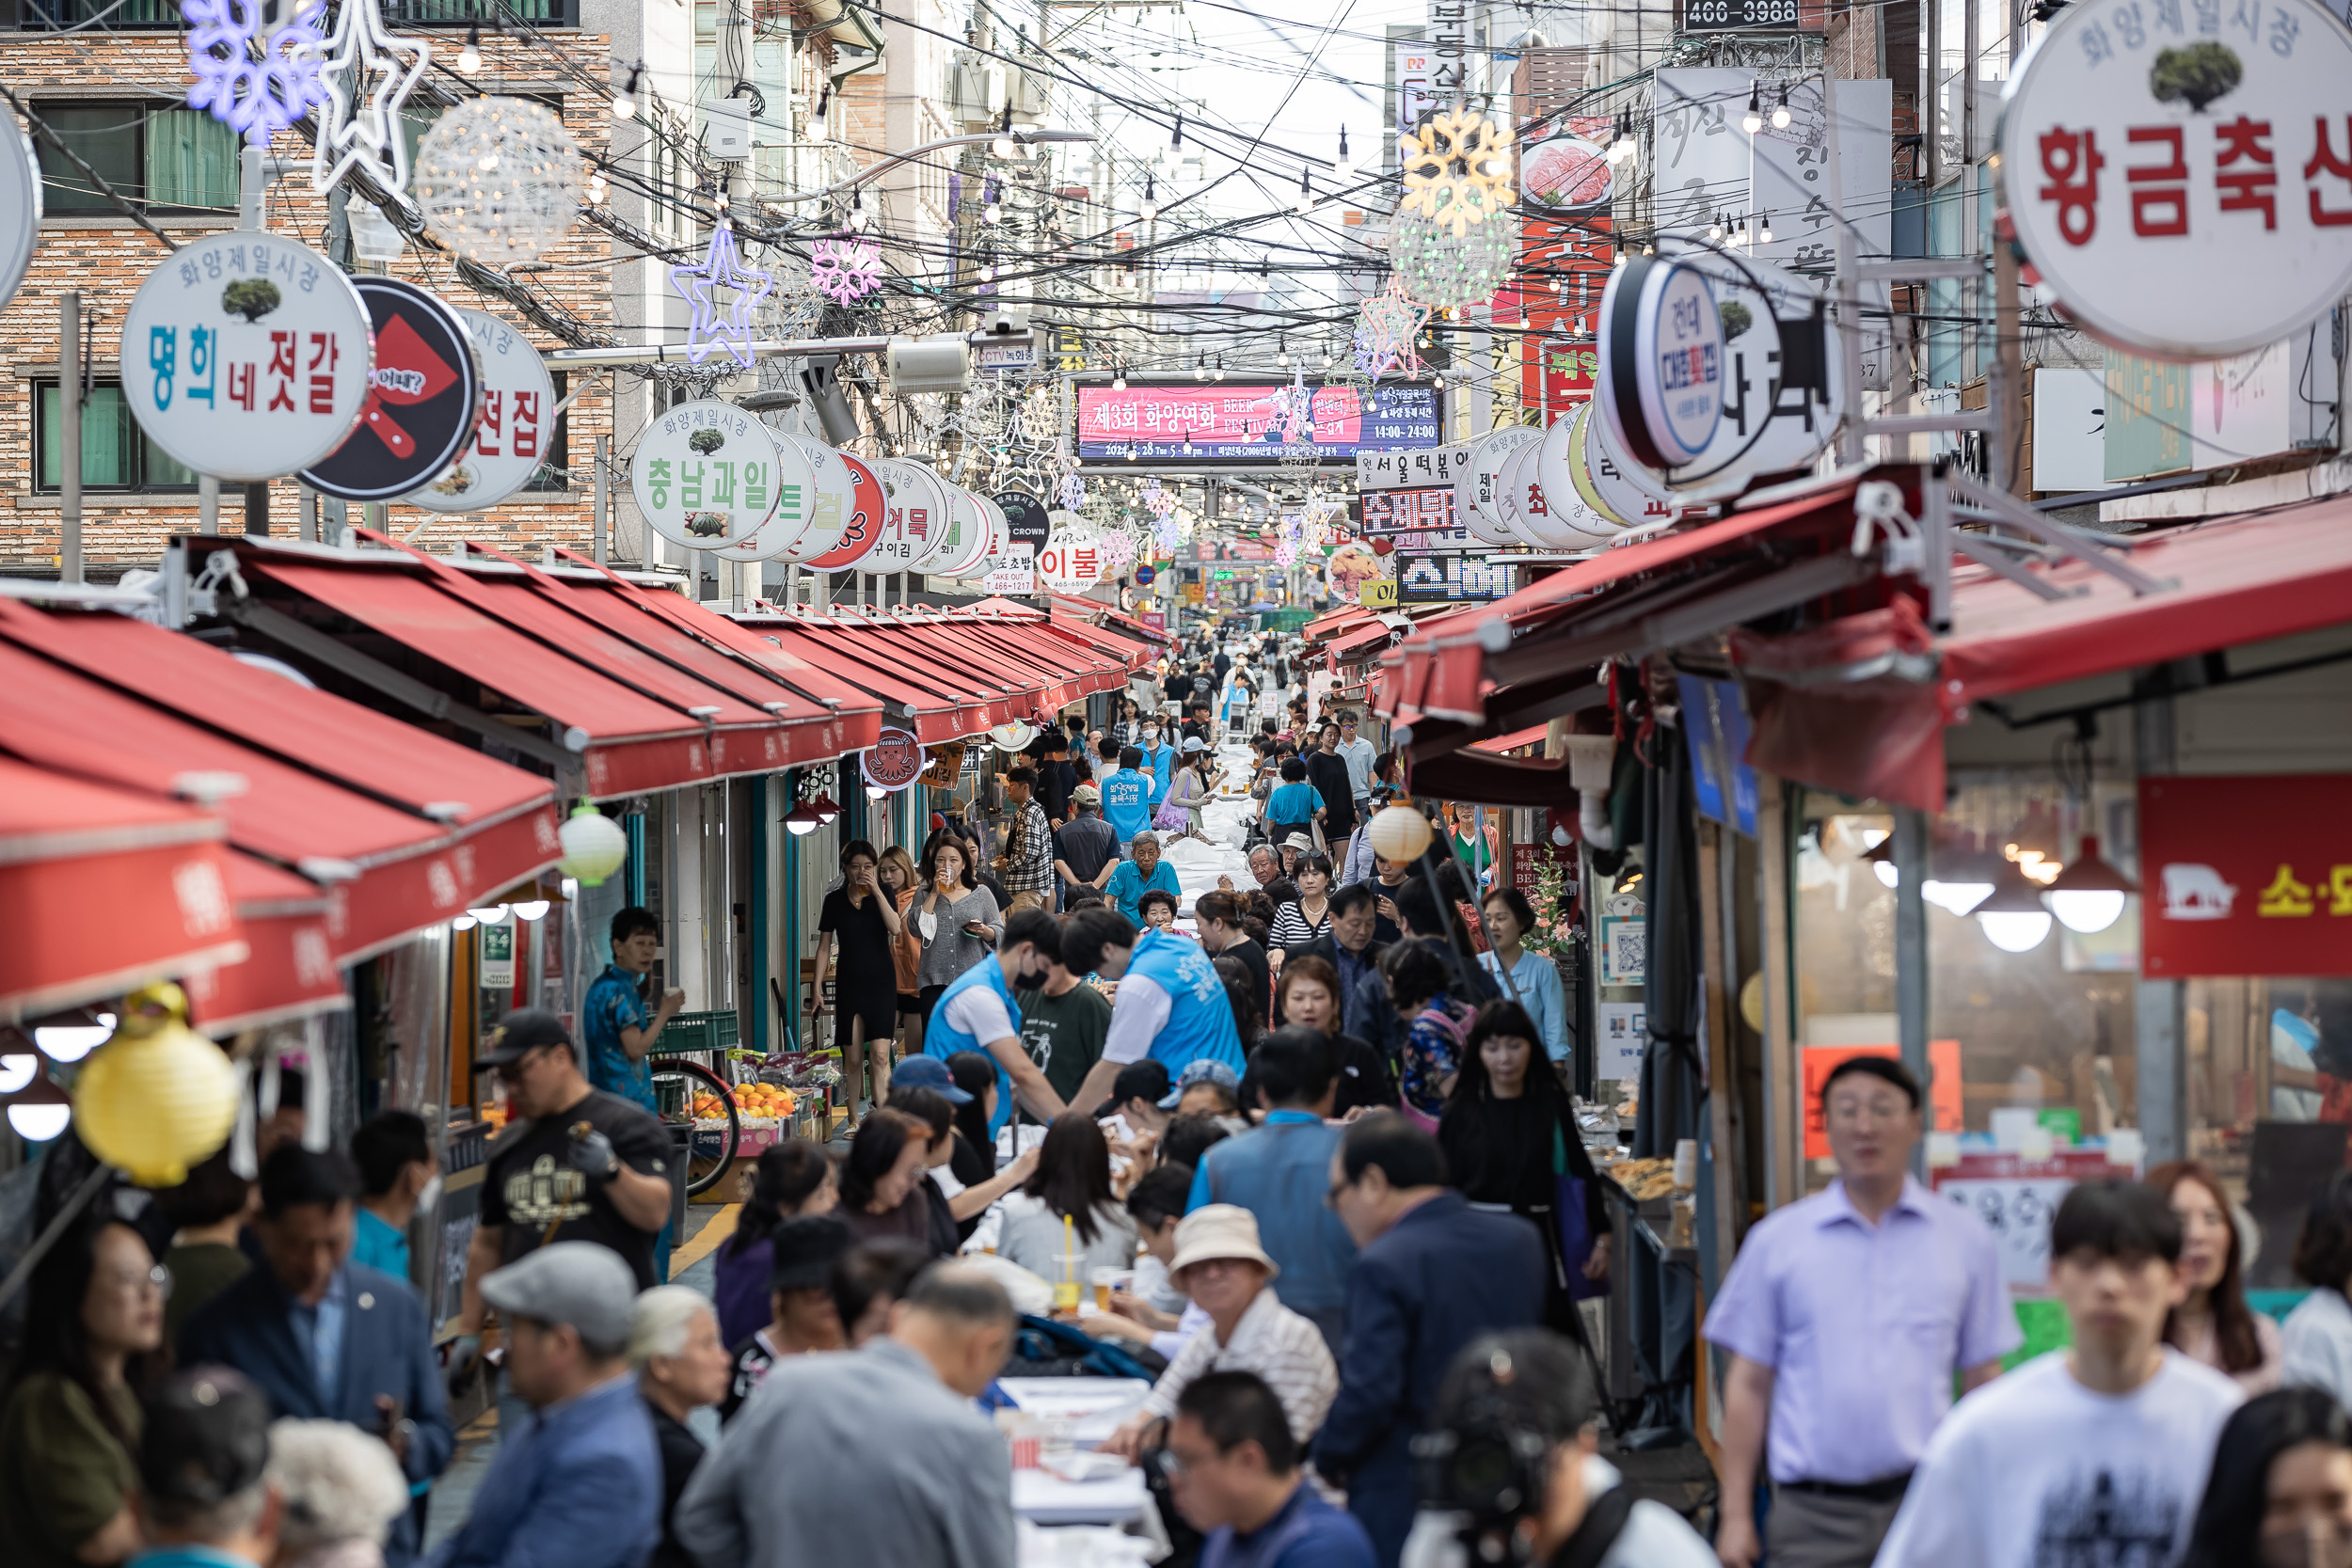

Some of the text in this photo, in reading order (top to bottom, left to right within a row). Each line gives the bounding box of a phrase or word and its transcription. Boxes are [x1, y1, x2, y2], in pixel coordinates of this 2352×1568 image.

[1689, 0, 1796, 23] 466-3988
[1433, 5, 1469, 87] 부동산
[2078, 0, 2301, 69] 화양제일시장
[2038, 114, 2352, 247] 황금축산
[178, 245, 321, 293] 화양제일시장
[1671, 293, 1700, 340] 건대
[979, 349, 1034, 362] CCTV 녹화중
[1093, 401, 1217, 433] 제3회 화양연화
[1223, 399, 1254, 413] BEER
[664, 408, 748, 437] 화양제일시장
[1224, 419, 1280, 433] FESTIVA
[1155, 447, 1168, 455] Tue
[648, 458, 767, 510] 충남과일
[1479, 473, 1491, 503] 제일
[888, 508, 929, 542] 어묵
[1053, 532, 1089, 545] 새로나
[1041, 548, 1099, 578] 이불
[986, 581, 1030, 591] T.466-1217
[1109, 782, 1139, 796] 화양제일
[1110, 794, 1138, 802] 골목시장
[1516, 861, 1548, 871] 화양화
